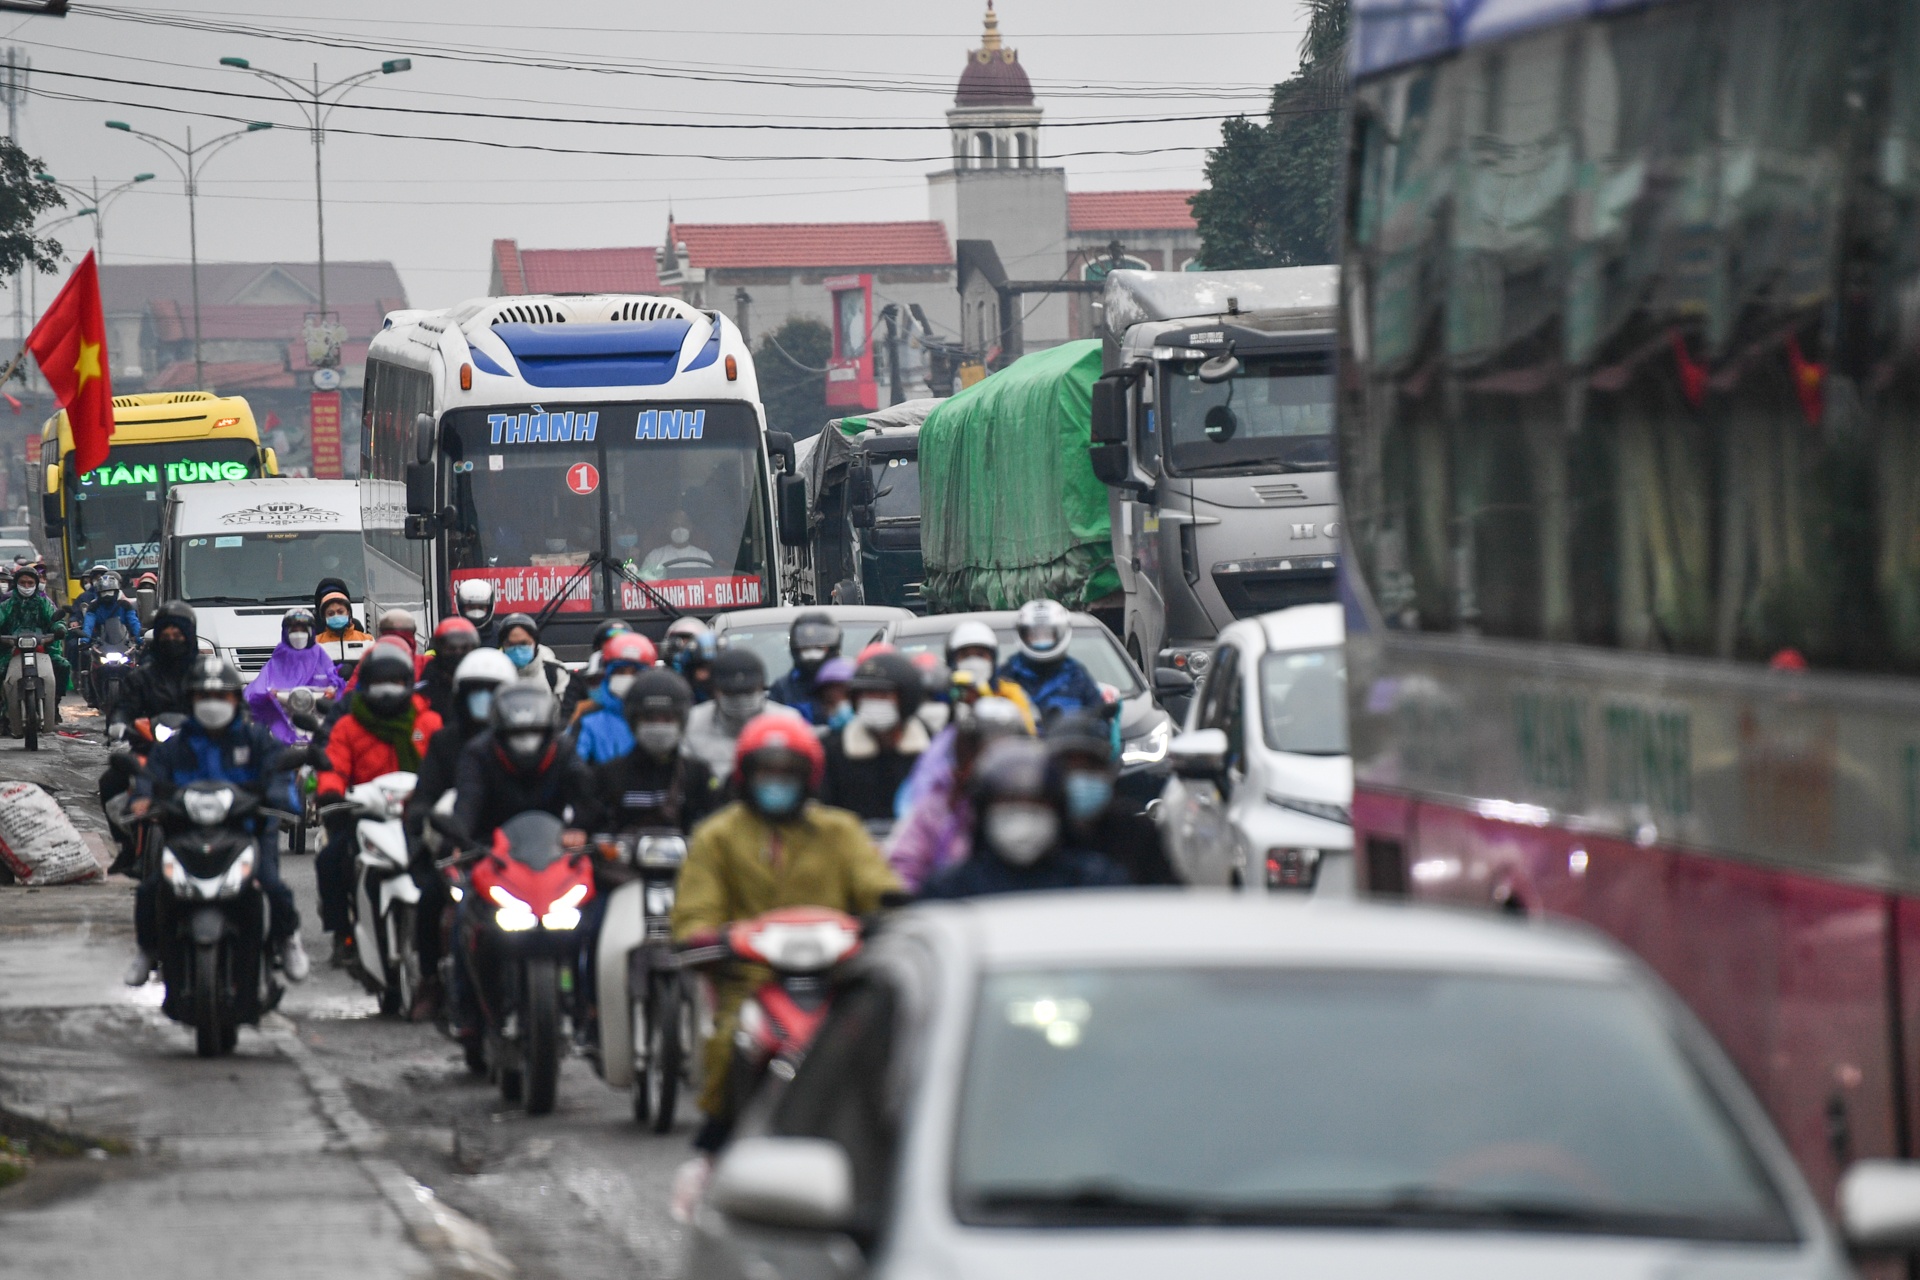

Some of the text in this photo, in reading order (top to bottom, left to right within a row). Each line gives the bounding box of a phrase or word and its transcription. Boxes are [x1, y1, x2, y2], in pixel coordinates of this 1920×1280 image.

[487, 404, 705, 444] THÀNH ANH
[95, 458, 249, 486] TÂN TÙNG
[574, 465, 592, 491] 1
[117, 544, 138, 556] HÀ
[687, 580, 705, 606] TRÌ
[715, 582, 734, 605] GIA
[735, 578, 759, 603] LÂM
